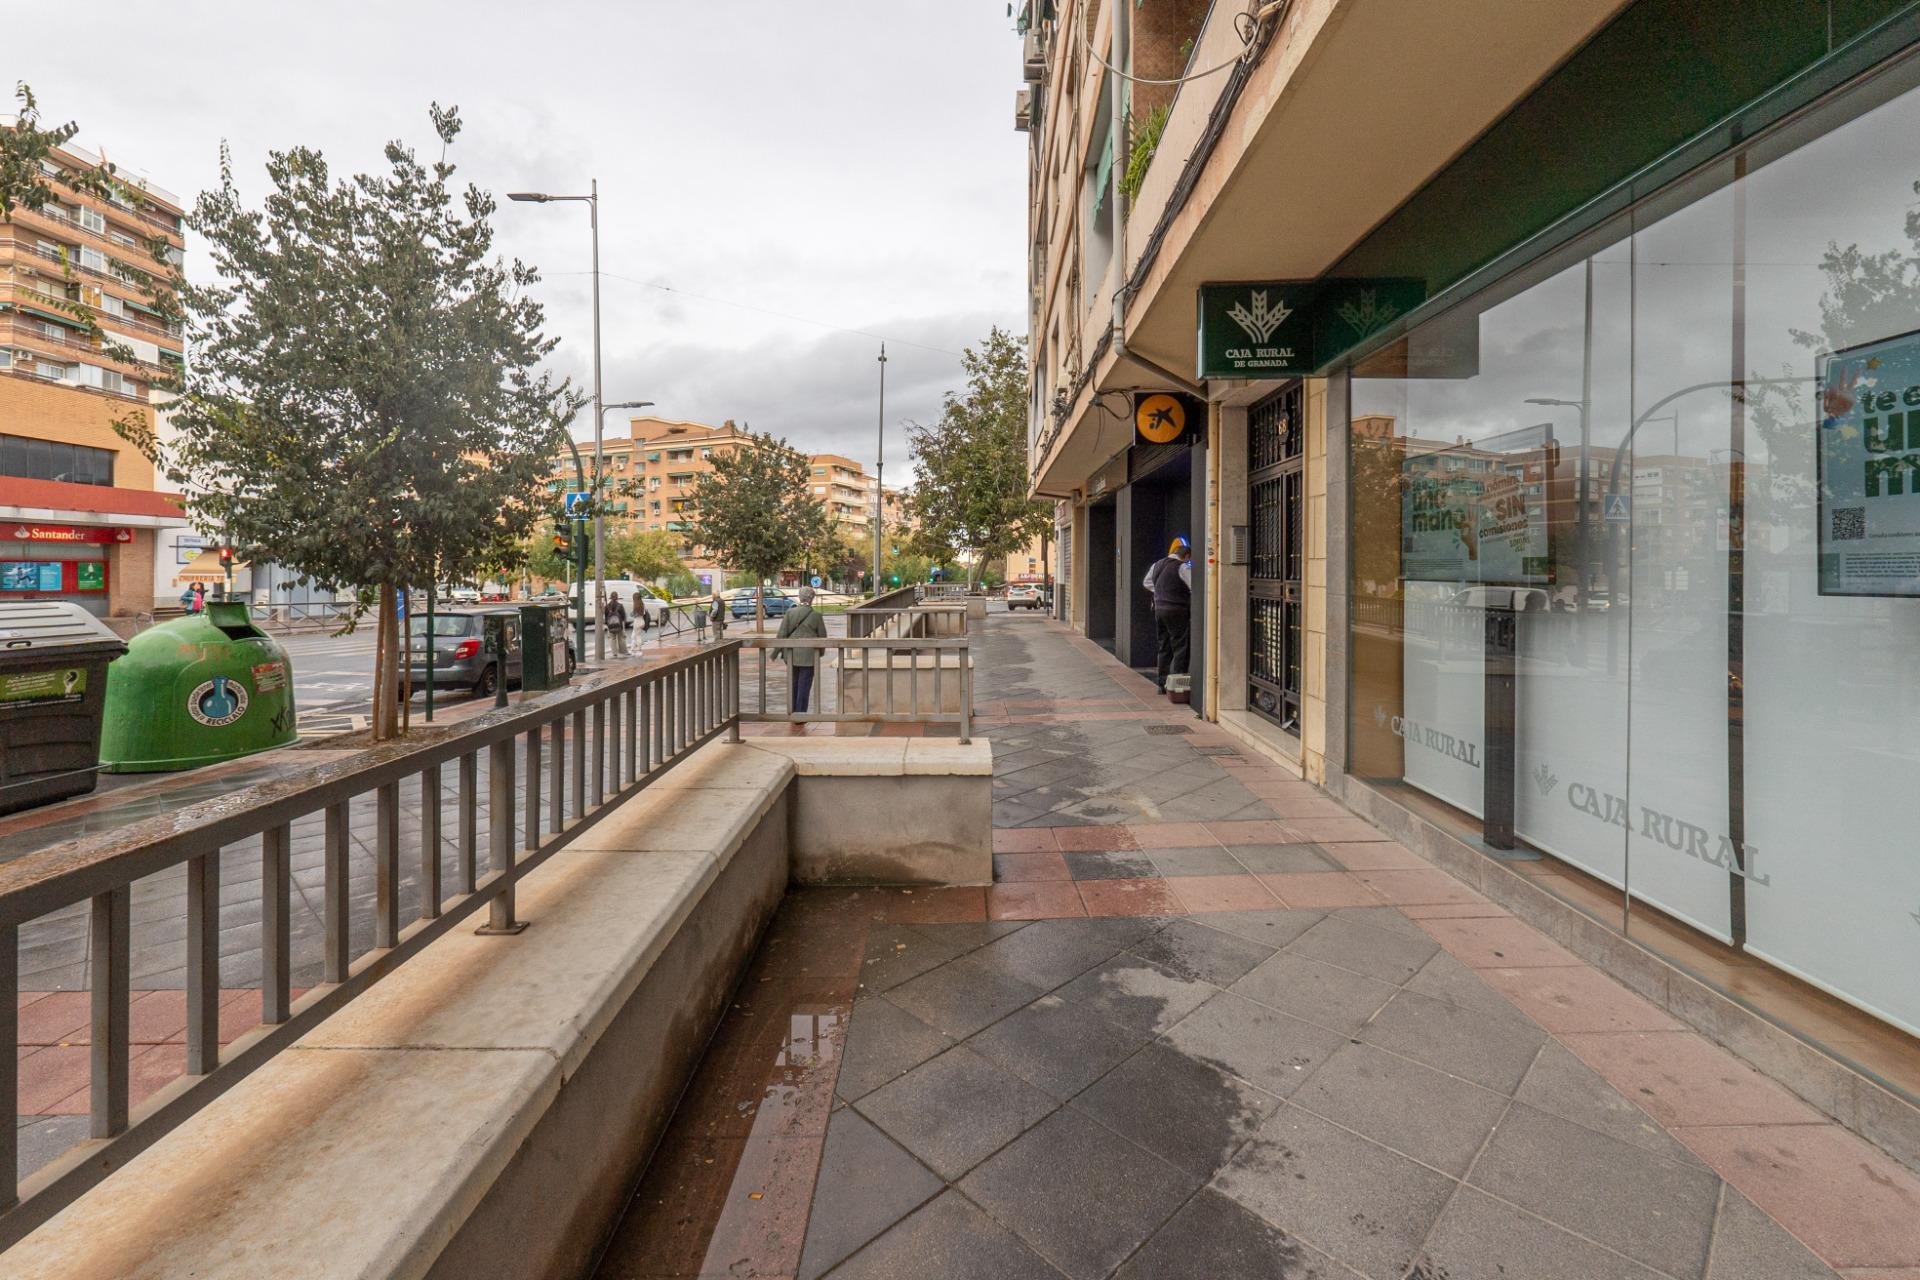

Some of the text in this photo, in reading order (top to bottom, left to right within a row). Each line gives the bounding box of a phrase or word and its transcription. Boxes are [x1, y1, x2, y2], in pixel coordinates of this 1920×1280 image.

[1225, 348, 1295, 358] CAJA RURAL
[1861, 390, 1897, 414] te
[1412, 507, 1466, 532] mano
[1495, 494, 1526, 521] SIN
[31, 528, 86, 540] Santander
[1479, 519, 1529, 539] comisiones
[1391, 715, 1481, 768] CAJA RURAL
[1567, 782, 1770, 887] CAJA RURAL
